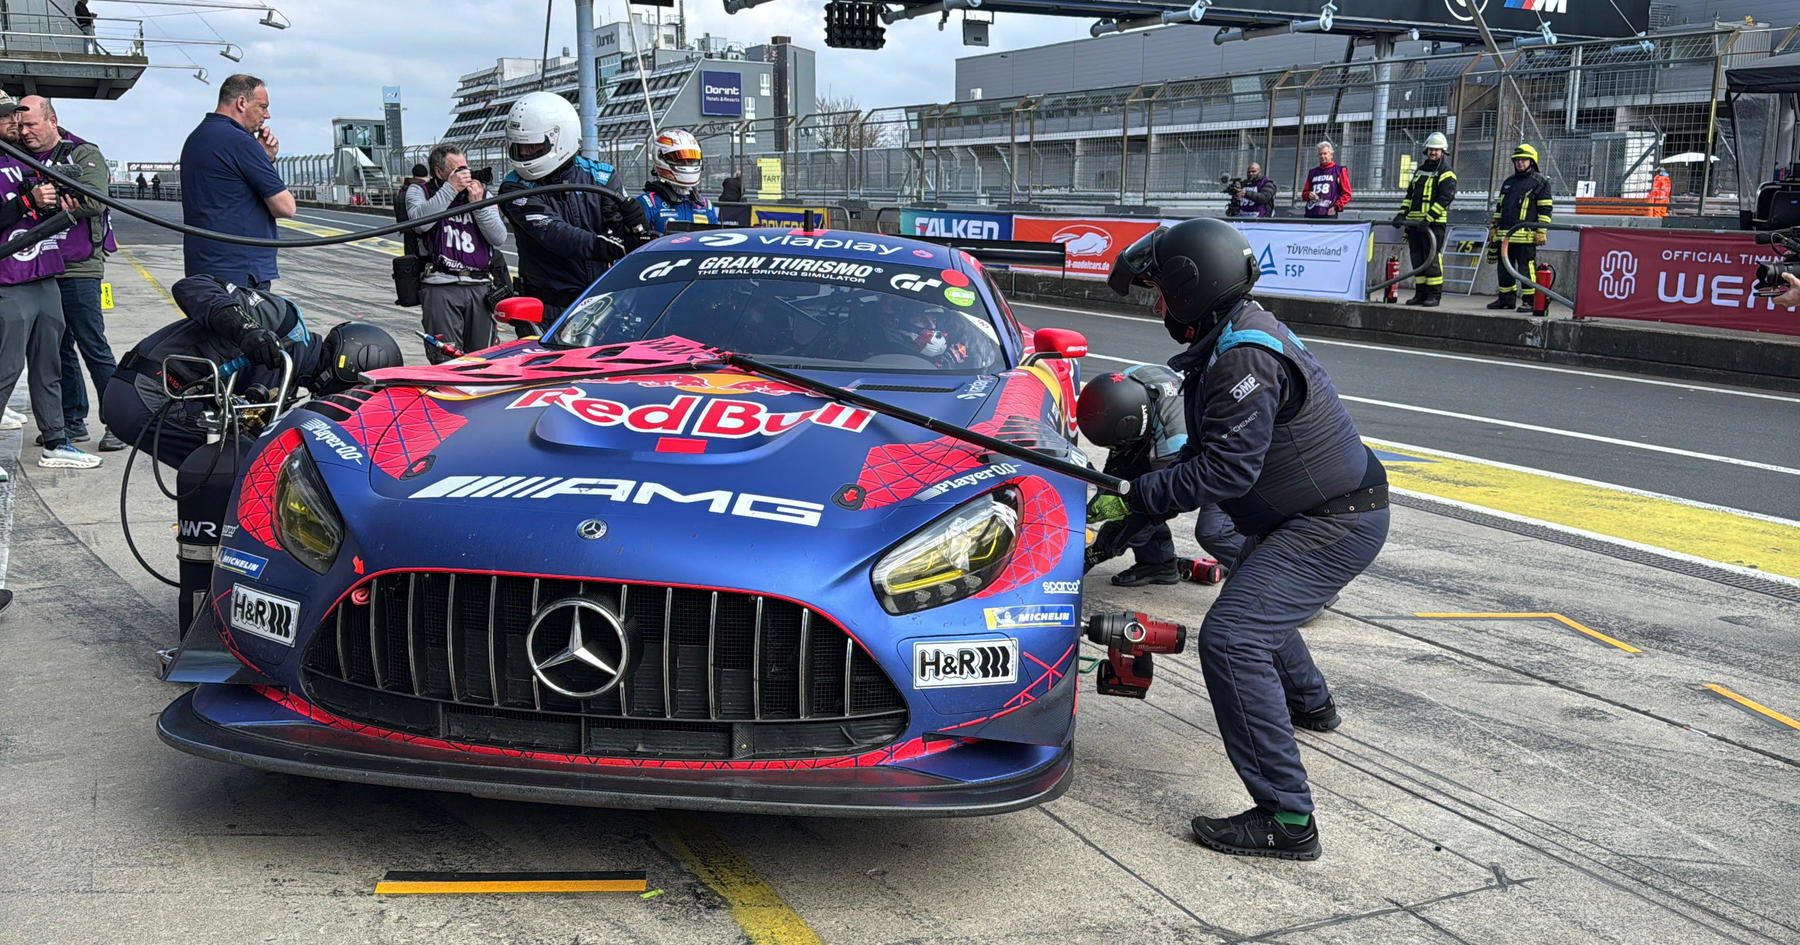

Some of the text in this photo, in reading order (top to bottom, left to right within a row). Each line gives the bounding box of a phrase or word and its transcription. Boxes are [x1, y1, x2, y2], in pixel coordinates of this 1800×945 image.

[705, 85, 740, 95] Dorint
[0, 166, 23, 183] TV
[1313, 183, 1331, 194] 158
[1584, 182, 1590, 194] 1
[915, 216, 999, 240] FALKEN
[759, 234, 903, 255] viaplay
[1458, 241, 1475, 253] 75
[698, 256, 767, 270] GRAN
[1661, 249, 1732, 264] OFFICIAL
[750, 269, 798, 277] DRIVING
[800, 272, 866, 284] SIMULATOR
[1284, 264, 1305, 277] FSP
[1232, 376, 1257, 399] OMP
[505, 386, 878, 438] Red Bull
[222, 555, 260, 572] MICHELIN
[1042, 580, 1081, 593] sparco
[1018, 611, 1070, 622] MICHELIN
[919, 649, 979, 681] H&R
